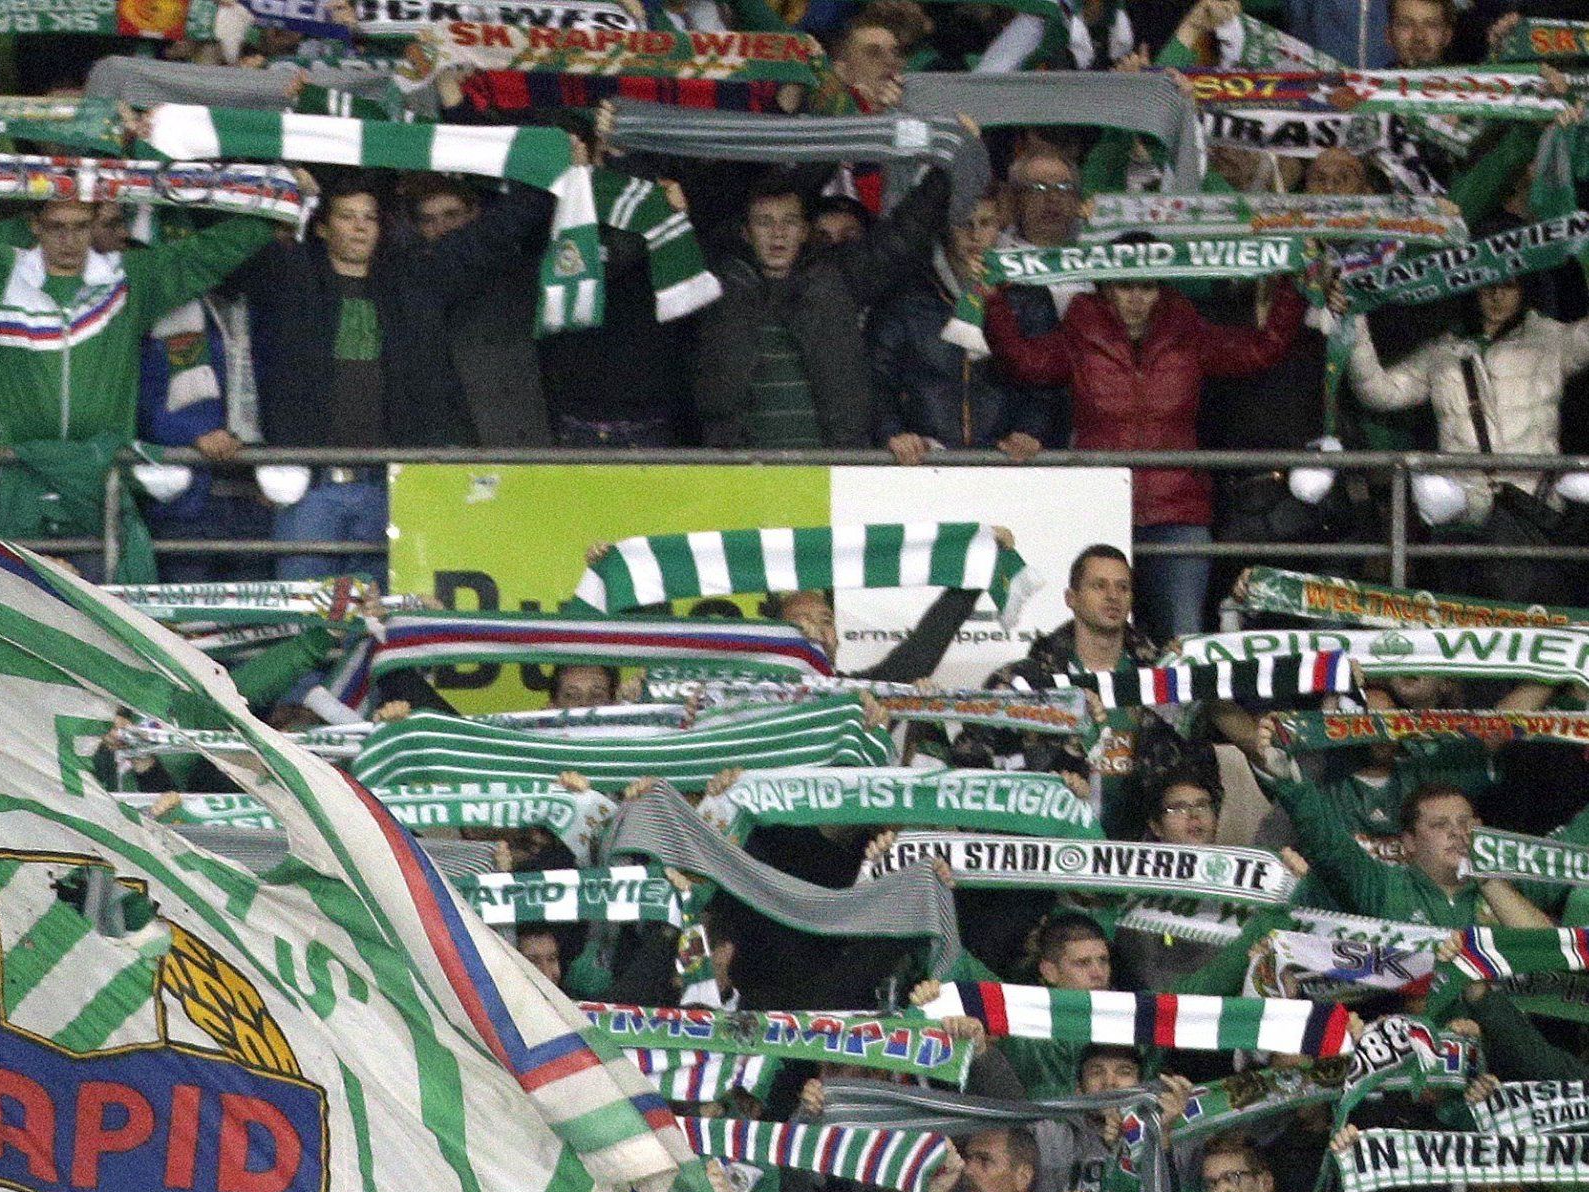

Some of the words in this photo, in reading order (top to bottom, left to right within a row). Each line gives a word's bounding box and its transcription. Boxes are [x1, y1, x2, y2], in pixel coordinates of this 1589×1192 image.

[450, 21, 515, 48] SK
[529, 26, 675, 55] RAPID
[692, 30, 815, 62] WIEN
[998, 252, 1049, 278] SK
[1060, 241, 1176, 272] RAPID
[1186, 239, 1290, 267] WIEN
[936, 776, 1094, 828] RELIGION
[763, 1009, 954, 1068] RAPID
[1355, 1135, 1402, 1174] IN
[1417, 1133, 1529, 1169] WIEN
